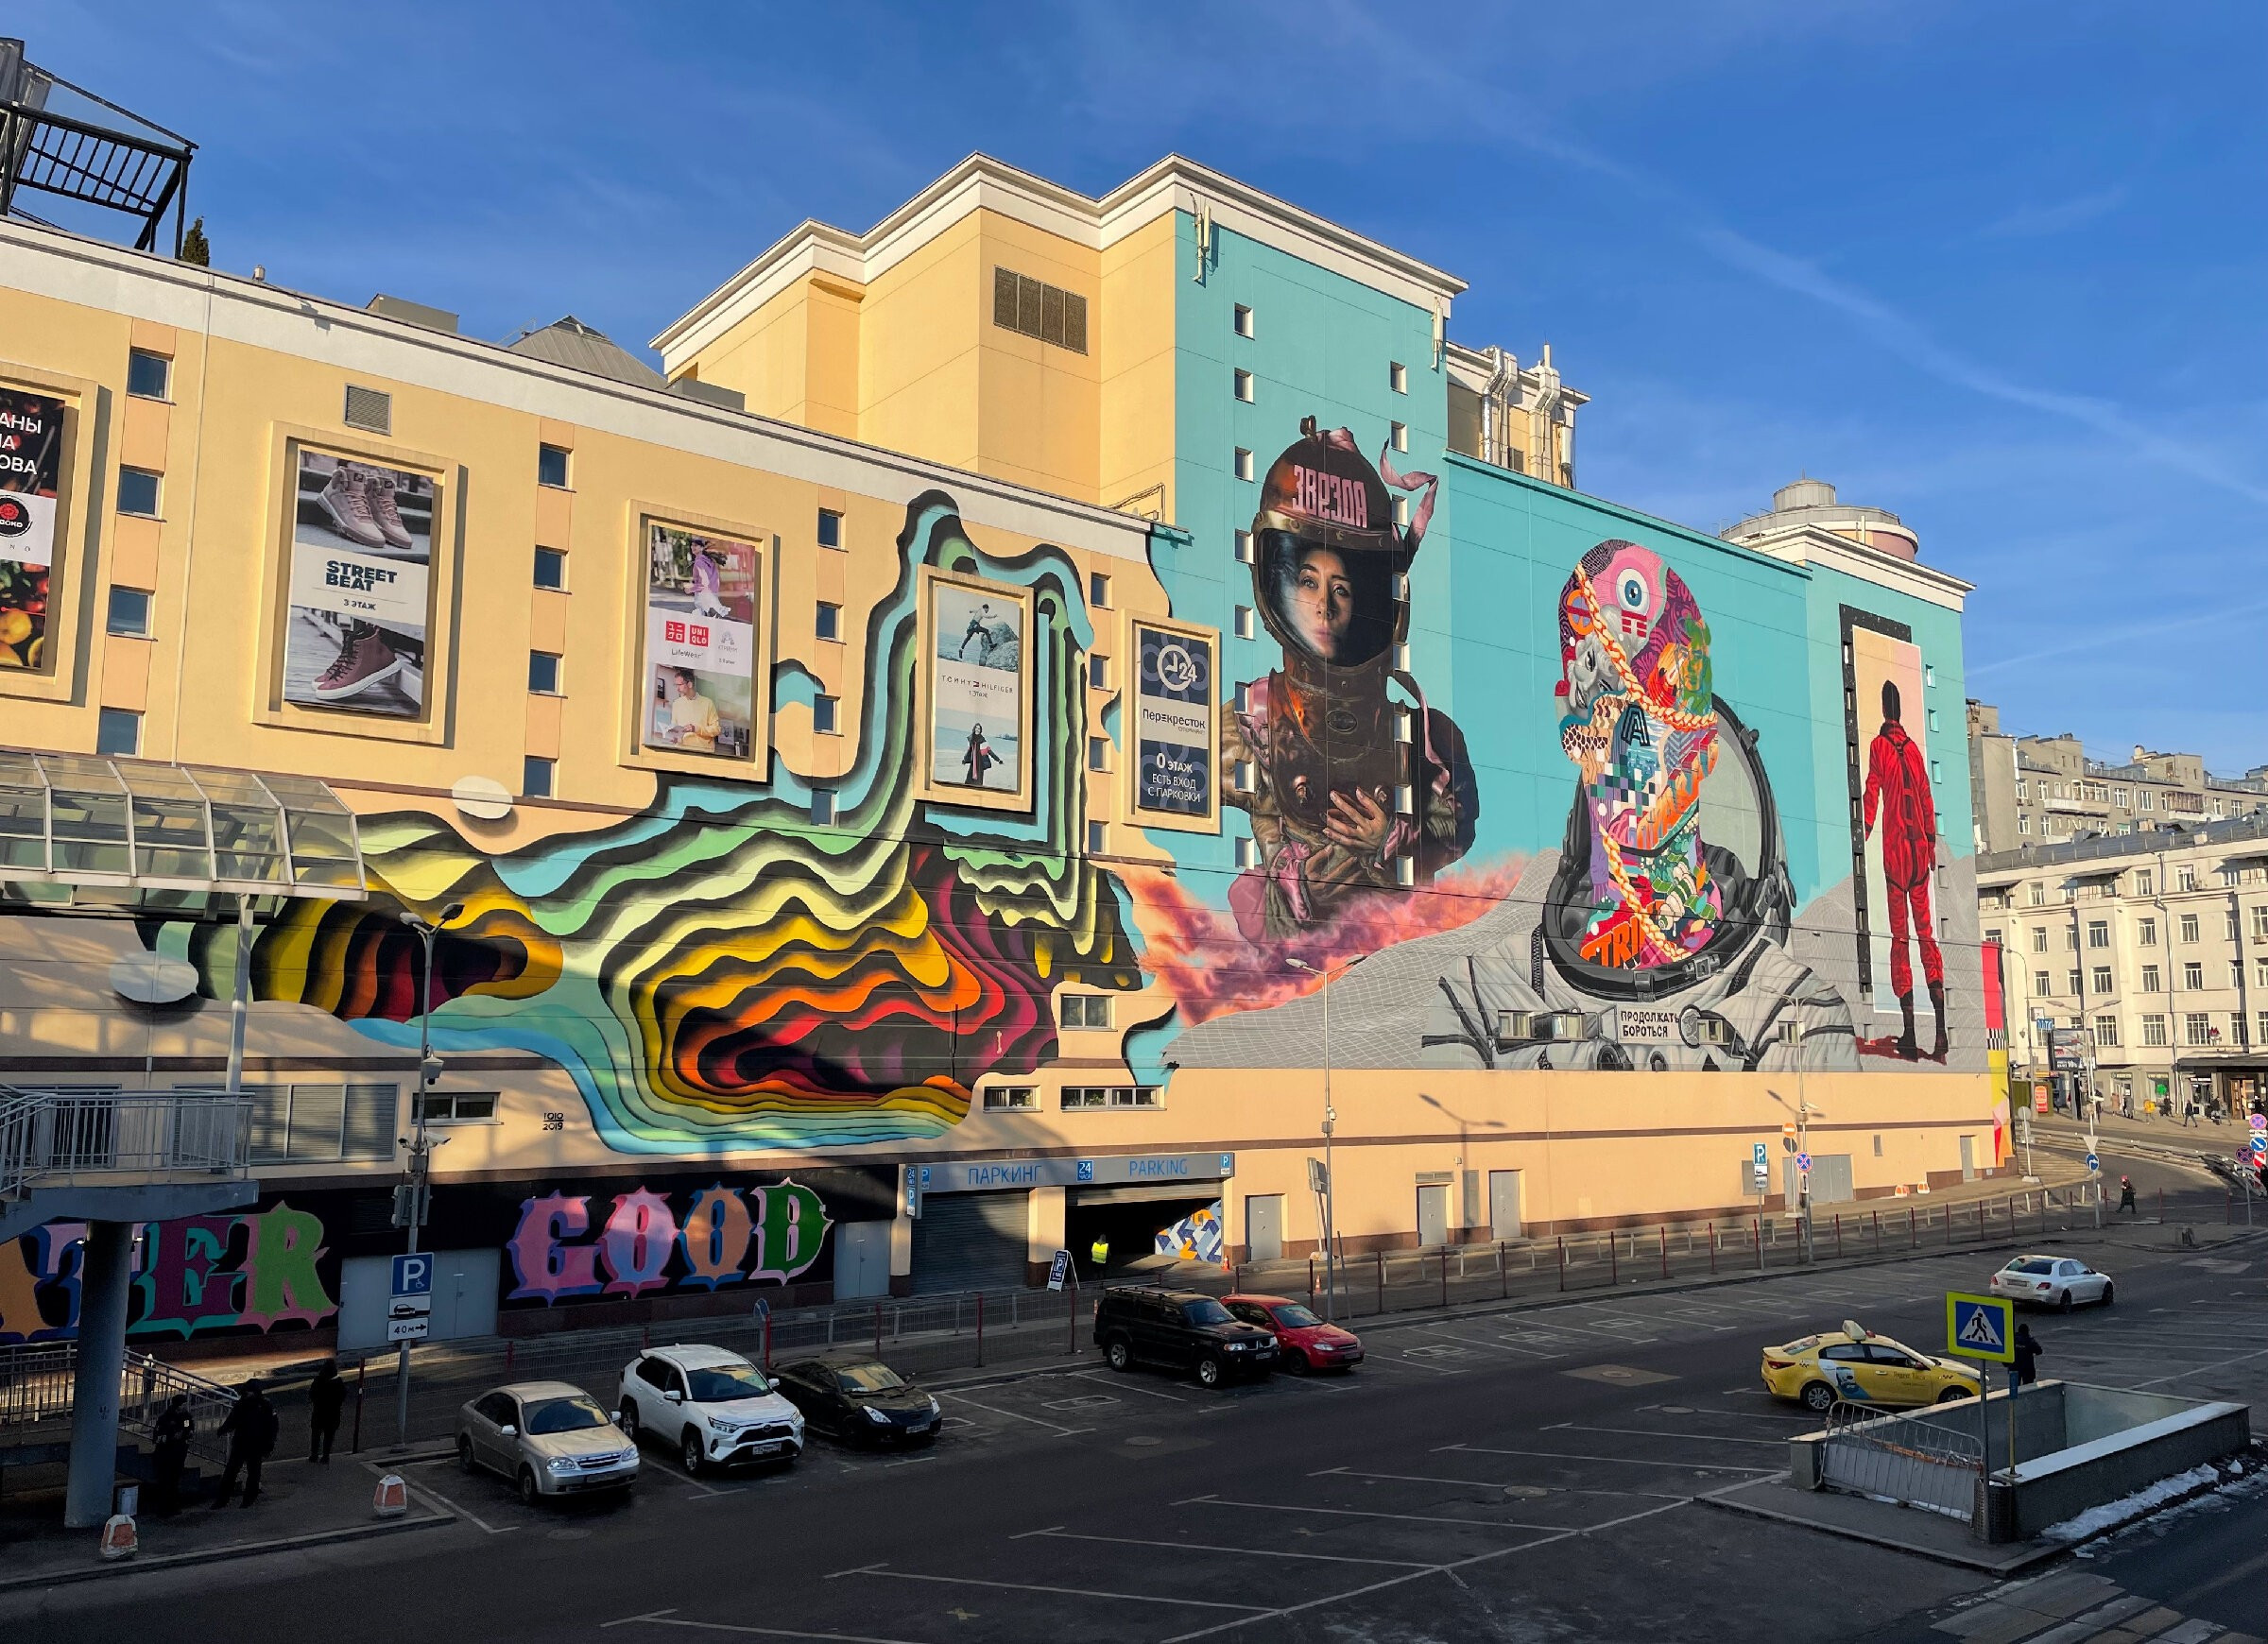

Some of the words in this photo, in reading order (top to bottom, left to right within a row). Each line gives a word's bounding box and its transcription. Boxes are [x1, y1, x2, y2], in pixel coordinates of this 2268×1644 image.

[326, 560, 398, 583] STREET
[325, 572, 375, 592] BEAT
[351, 600, 376, 611] ЭТАЖ
[1178, 662, 1198, 682] 24
[981, 683, 1014, 694] HILFIGER
[1143, 708, 1207, 729] Перекресток
[1156, 752, 1166, 769] 0
[1167, 761, 1193, 774] ЭТАЖ
[1152, 773, 1172, 785] ЕСТЬ
[1173, 776, 1197, 792] ВХОД
[1147, 786, 1155, 796] С
[1156, 787, 1201, 803] ПАРКОВКИ
[1620, 1010, 1680, 1025] ПРОДОЛЖАТЬ
[1623, 1024, 1669, 1038] БОРОТЬСЯ
[542, 1122, 564, 1131] 2019
[968, 1165, 1042, 1186] ПАРКИНГ
[1078, 1162, 1092, 1174] 24
[1128, 1158, 1188, 1177] PARKING
[506, 1176, 835, 1309] GOOD
